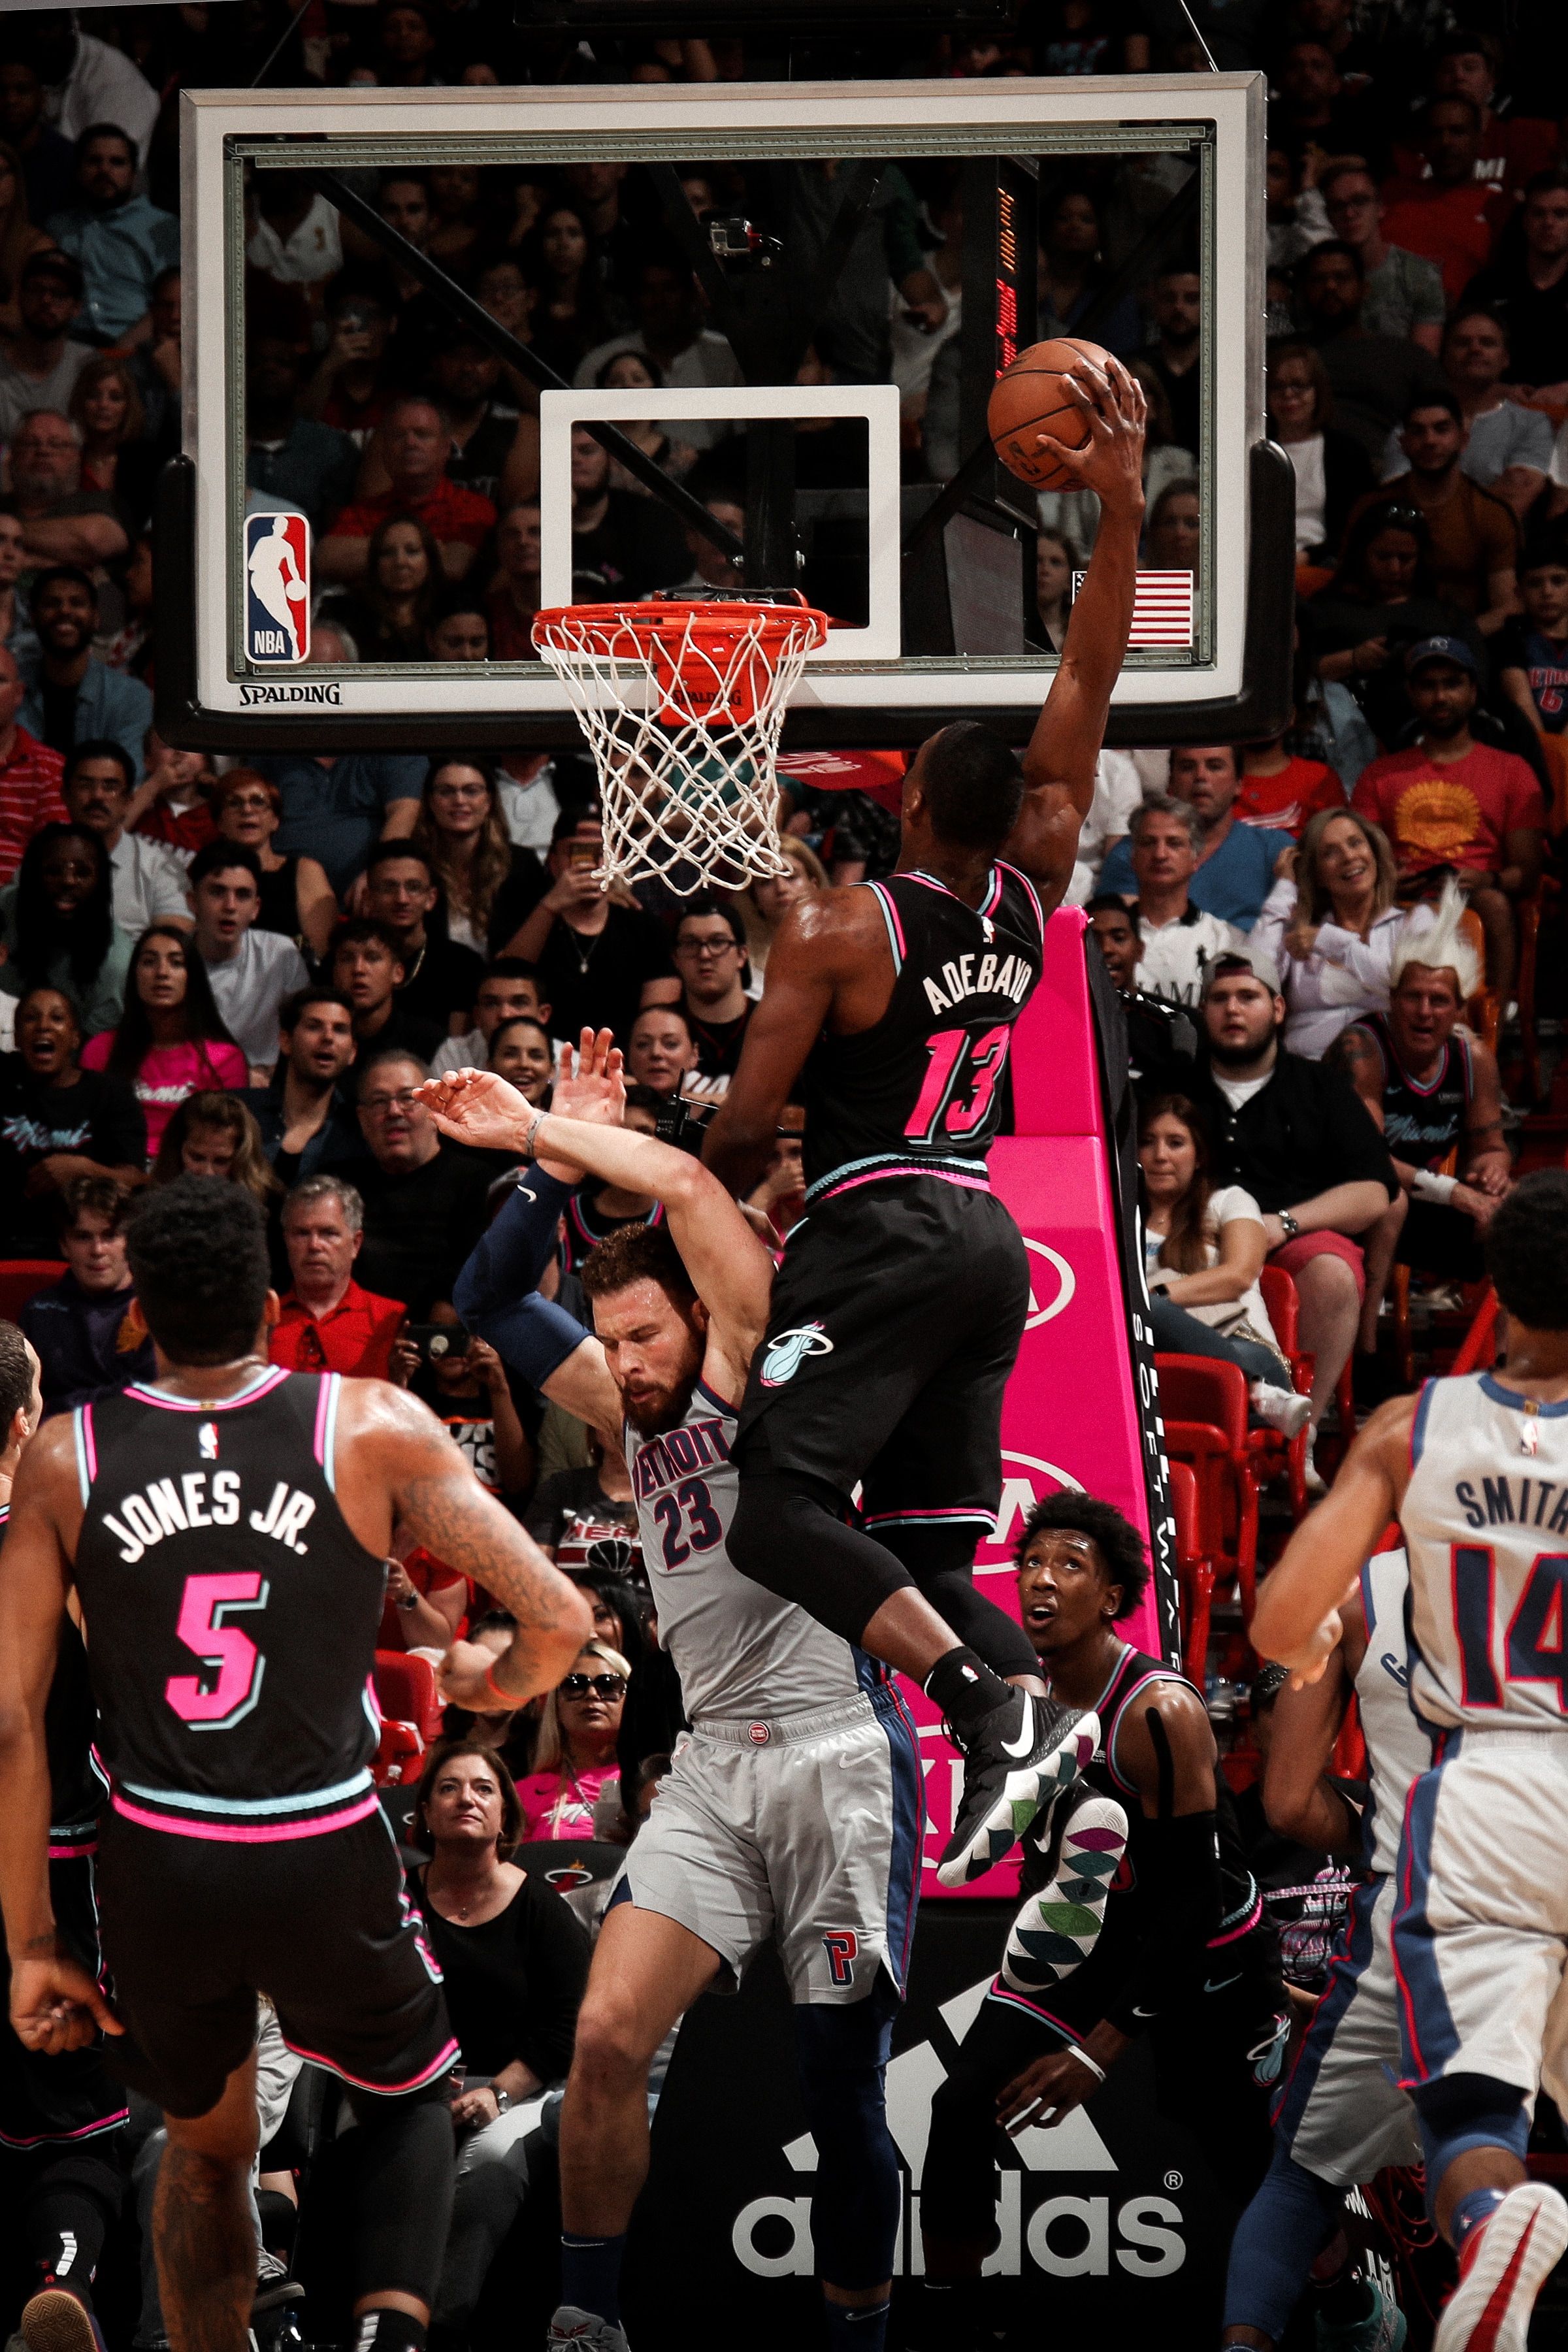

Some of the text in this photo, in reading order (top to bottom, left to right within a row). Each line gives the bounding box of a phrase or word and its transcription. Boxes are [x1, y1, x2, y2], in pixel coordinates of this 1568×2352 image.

[253, 630, 286, 654] NBA
[239, 683, 340, 706] SPALDING
[673, 689, 742, 706] SPALDG
[1540, 686, 1563, 713] 6
[922, 953, 1032, 1015] ADEBAYO
[903, 1024, 1011, 1145] 13
[102, 1469, 316, 1563] JONES JR.
[653, 1477, 723, 1571] 23
[164, 1571, 270, 1732] 5
[1450, 1543, 1568, 1714] 14
[732, 2170, 1187, 2278] aidas
